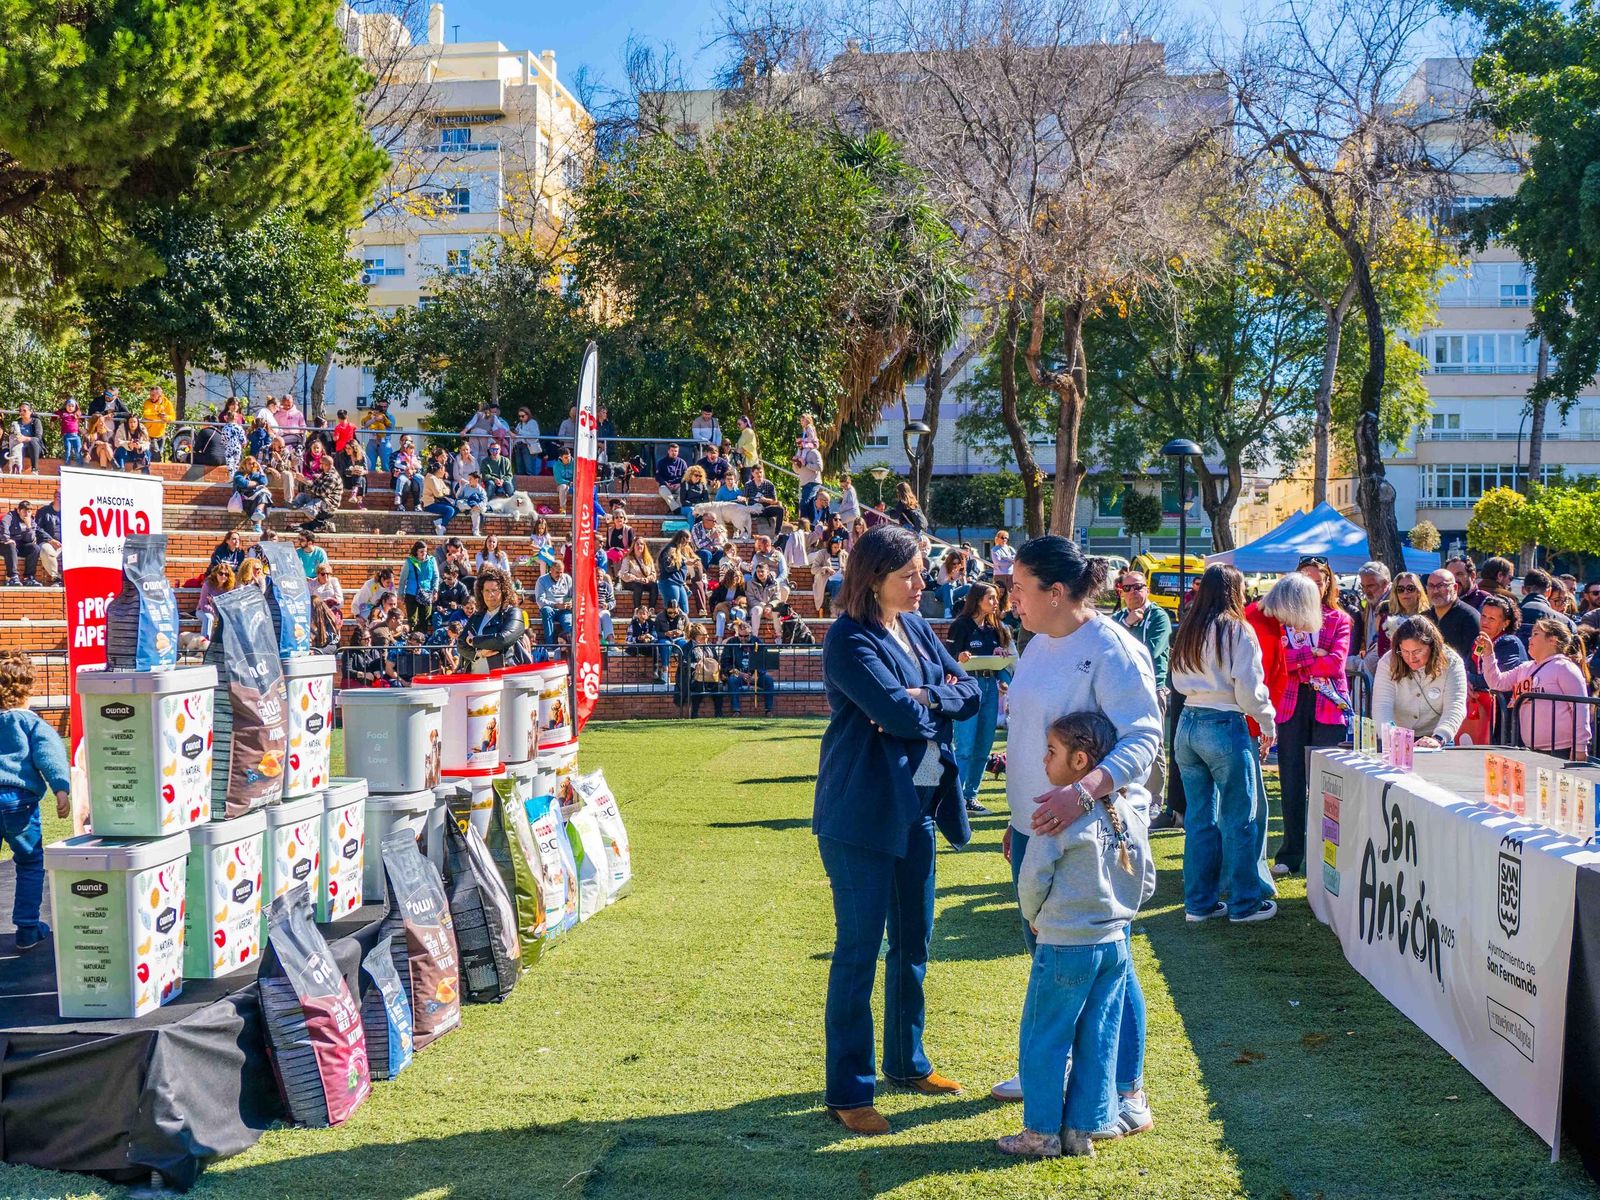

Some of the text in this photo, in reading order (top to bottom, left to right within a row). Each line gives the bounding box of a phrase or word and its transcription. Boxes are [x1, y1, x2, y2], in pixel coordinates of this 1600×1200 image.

[96, 495, 134, 507] MASCOTAS
[74, 625, 107, 648] APE
[105, 706, 130, 714] ownat
[367, 731, 389, 739] Food
[368, 756, 388, 764] Love
[1381, 781, 1417, 867] San
[1500, 862, 1519, 888] SAN
[76, 883, 103, 891] ownat
[1359, 837, 1455, 984] Antón 2025
[1487, 939, 1536, 976] Ayuntamiento de
[83, 975, 108, 983] NATURAL
[1486, 956, 1537, 997] San Fernando
